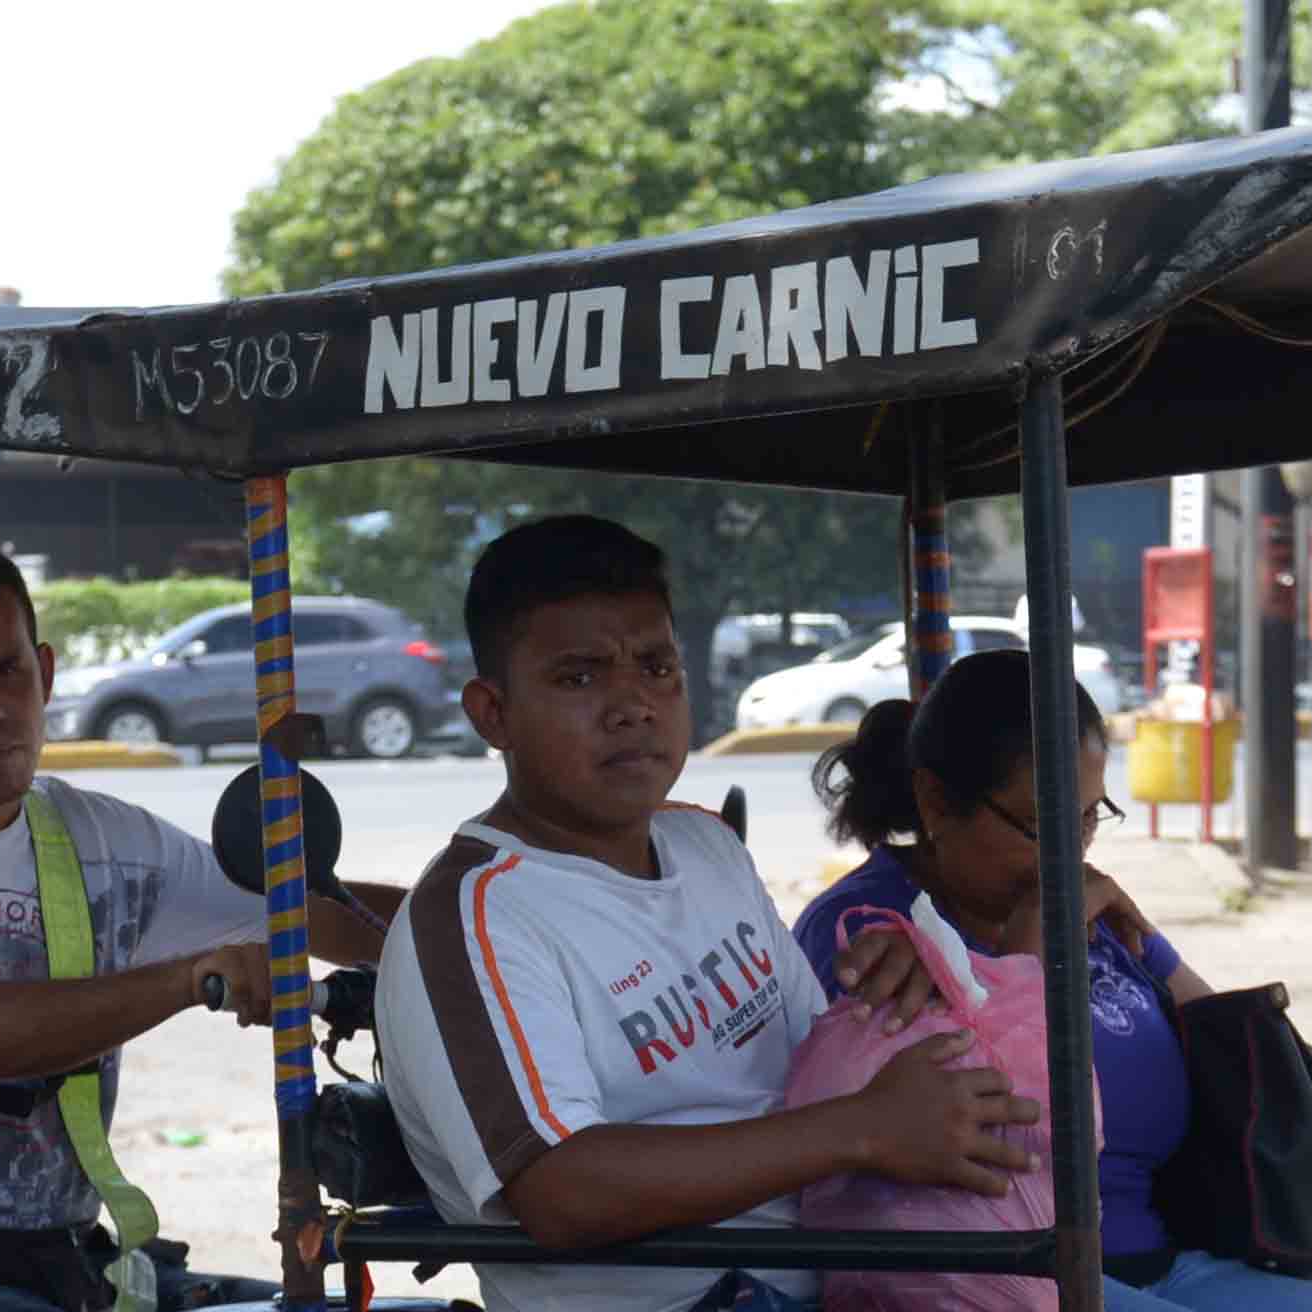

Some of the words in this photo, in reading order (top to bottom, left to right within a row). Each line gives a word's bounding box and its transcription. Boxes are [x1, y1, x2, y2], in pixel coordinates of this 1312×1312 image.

[130, 329, 330, 421] M53087
[363, 286, 627, 414] NUEVO
[618, 921, 774, 1076] RUSTIC
